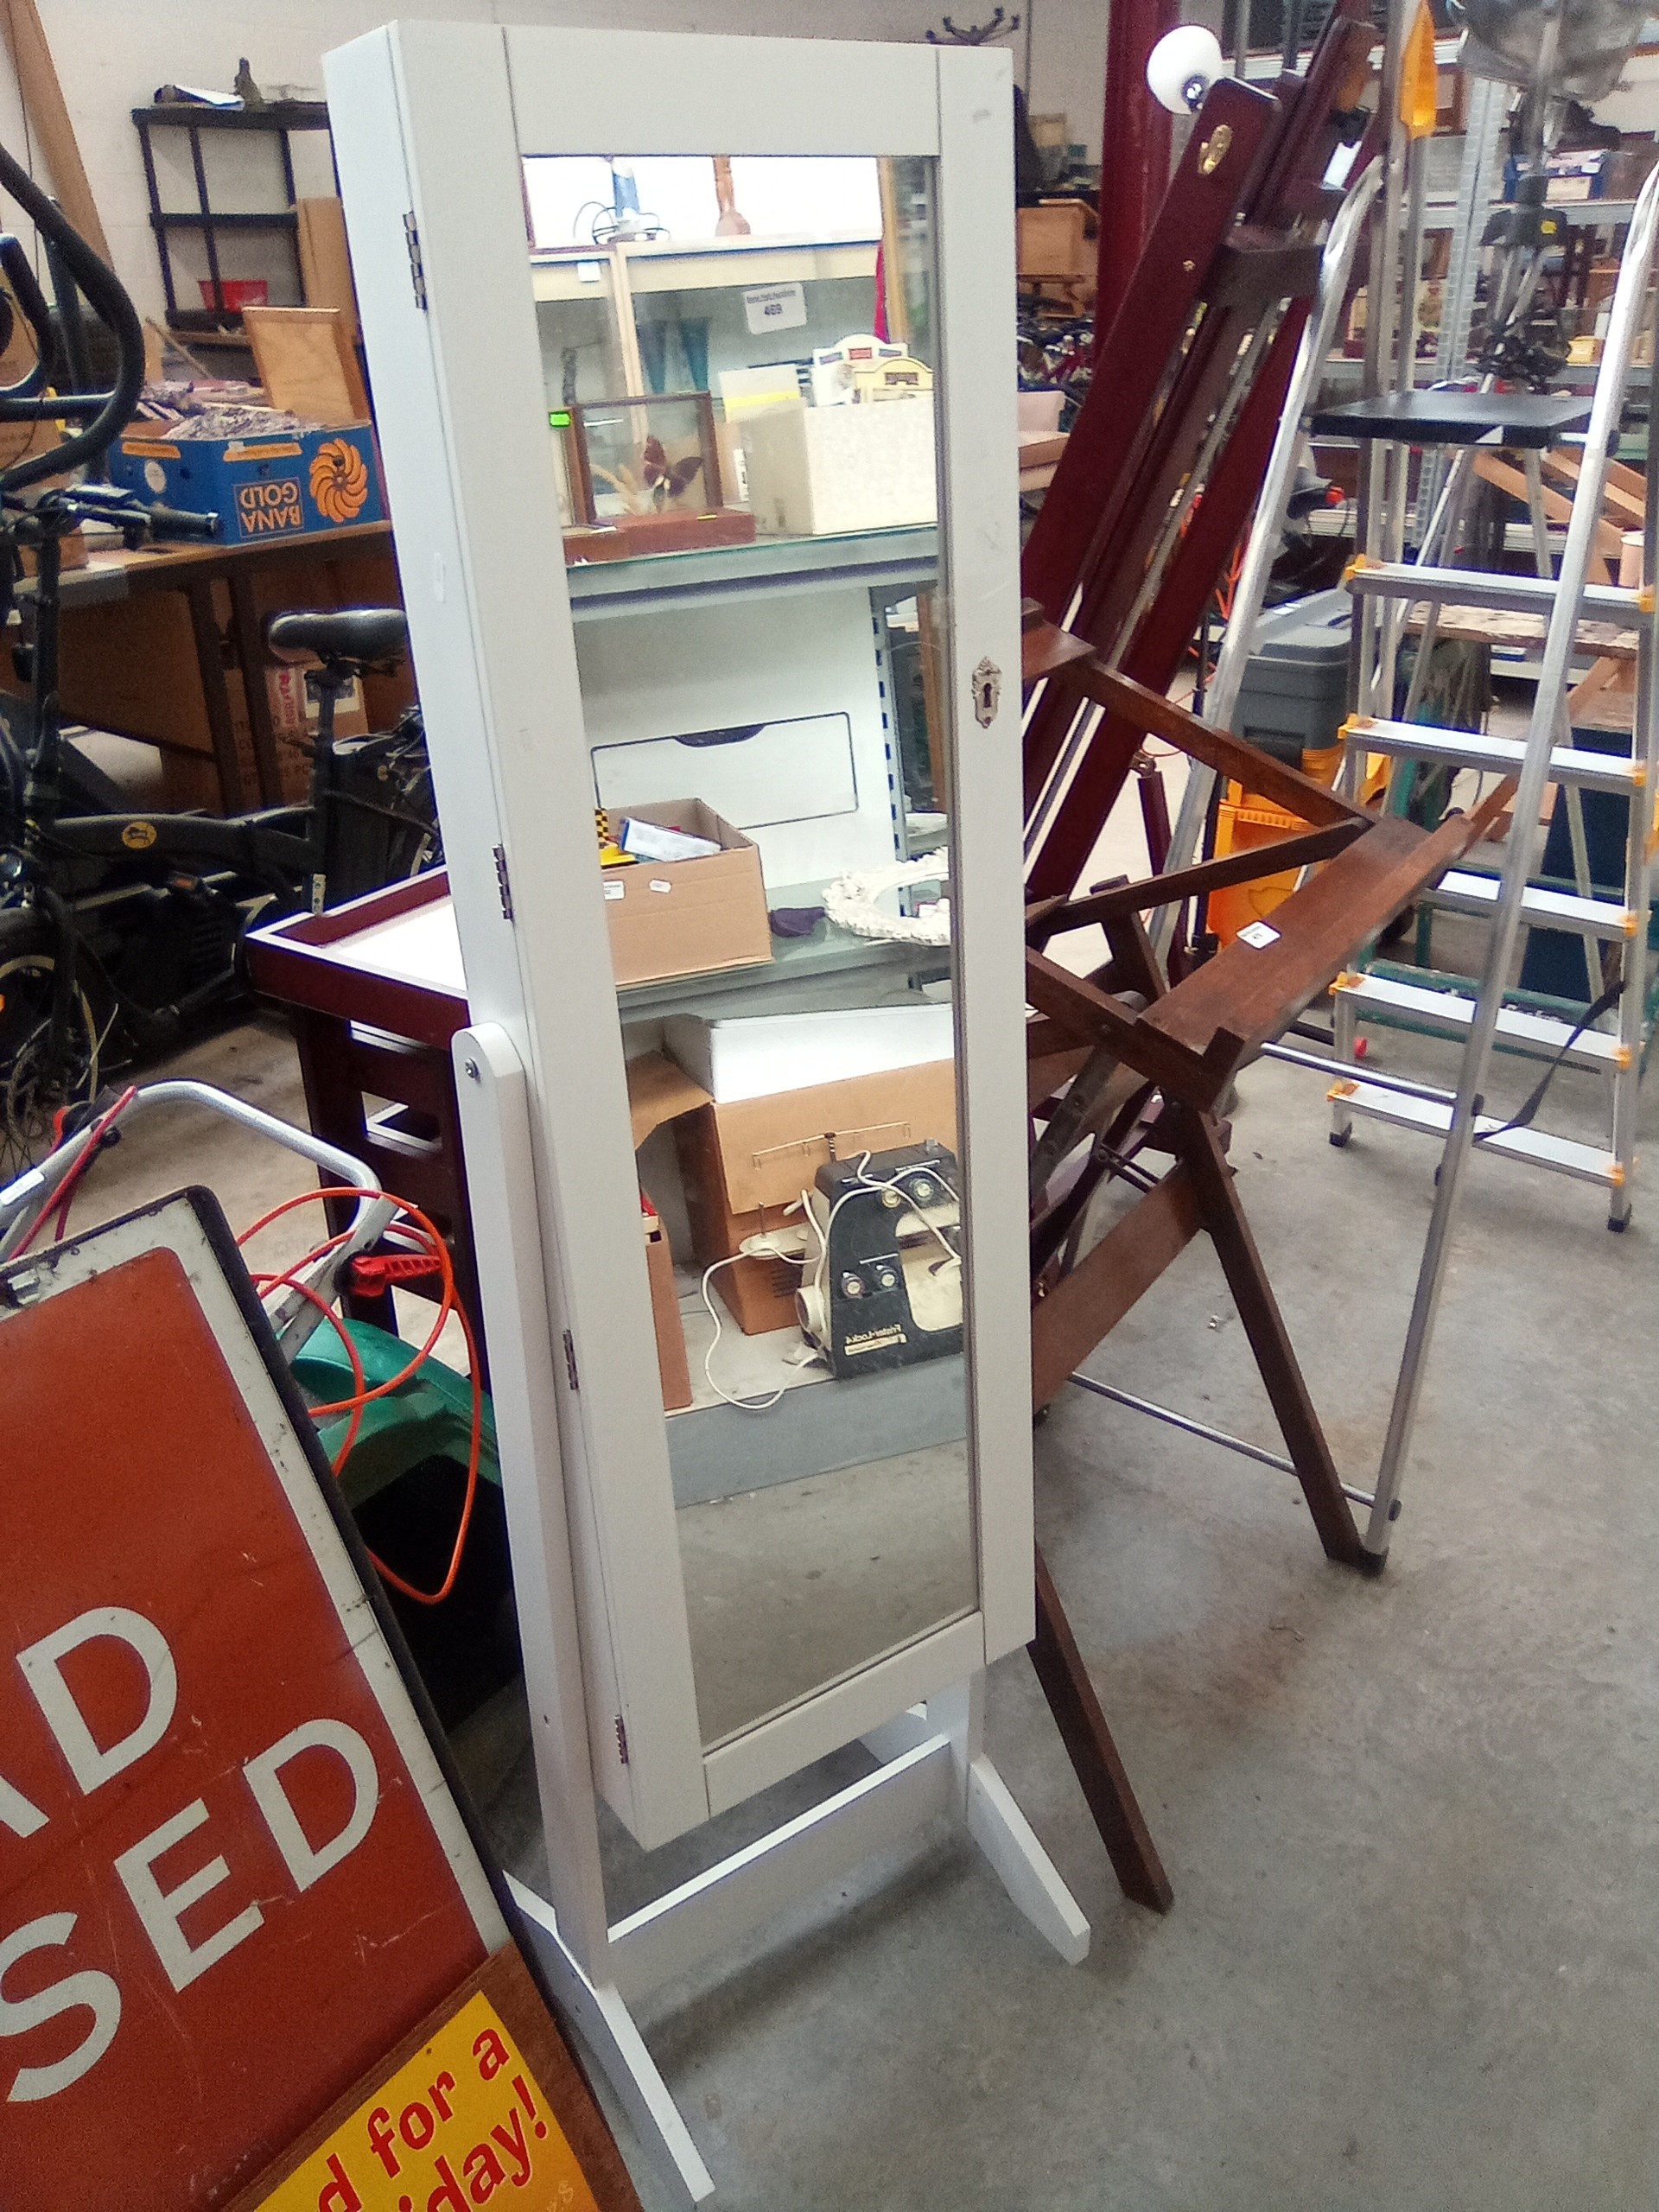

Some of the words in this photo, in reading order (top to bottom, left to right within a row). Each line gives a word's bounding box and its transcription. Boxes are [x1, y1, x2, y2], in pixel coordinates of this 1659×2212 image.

[239, 480, 299, 510] GOLD
[240, 505, 302, 533] BANA
[367, 2070, 455, 2179] for
[473, 2028, 511, 2081] a
